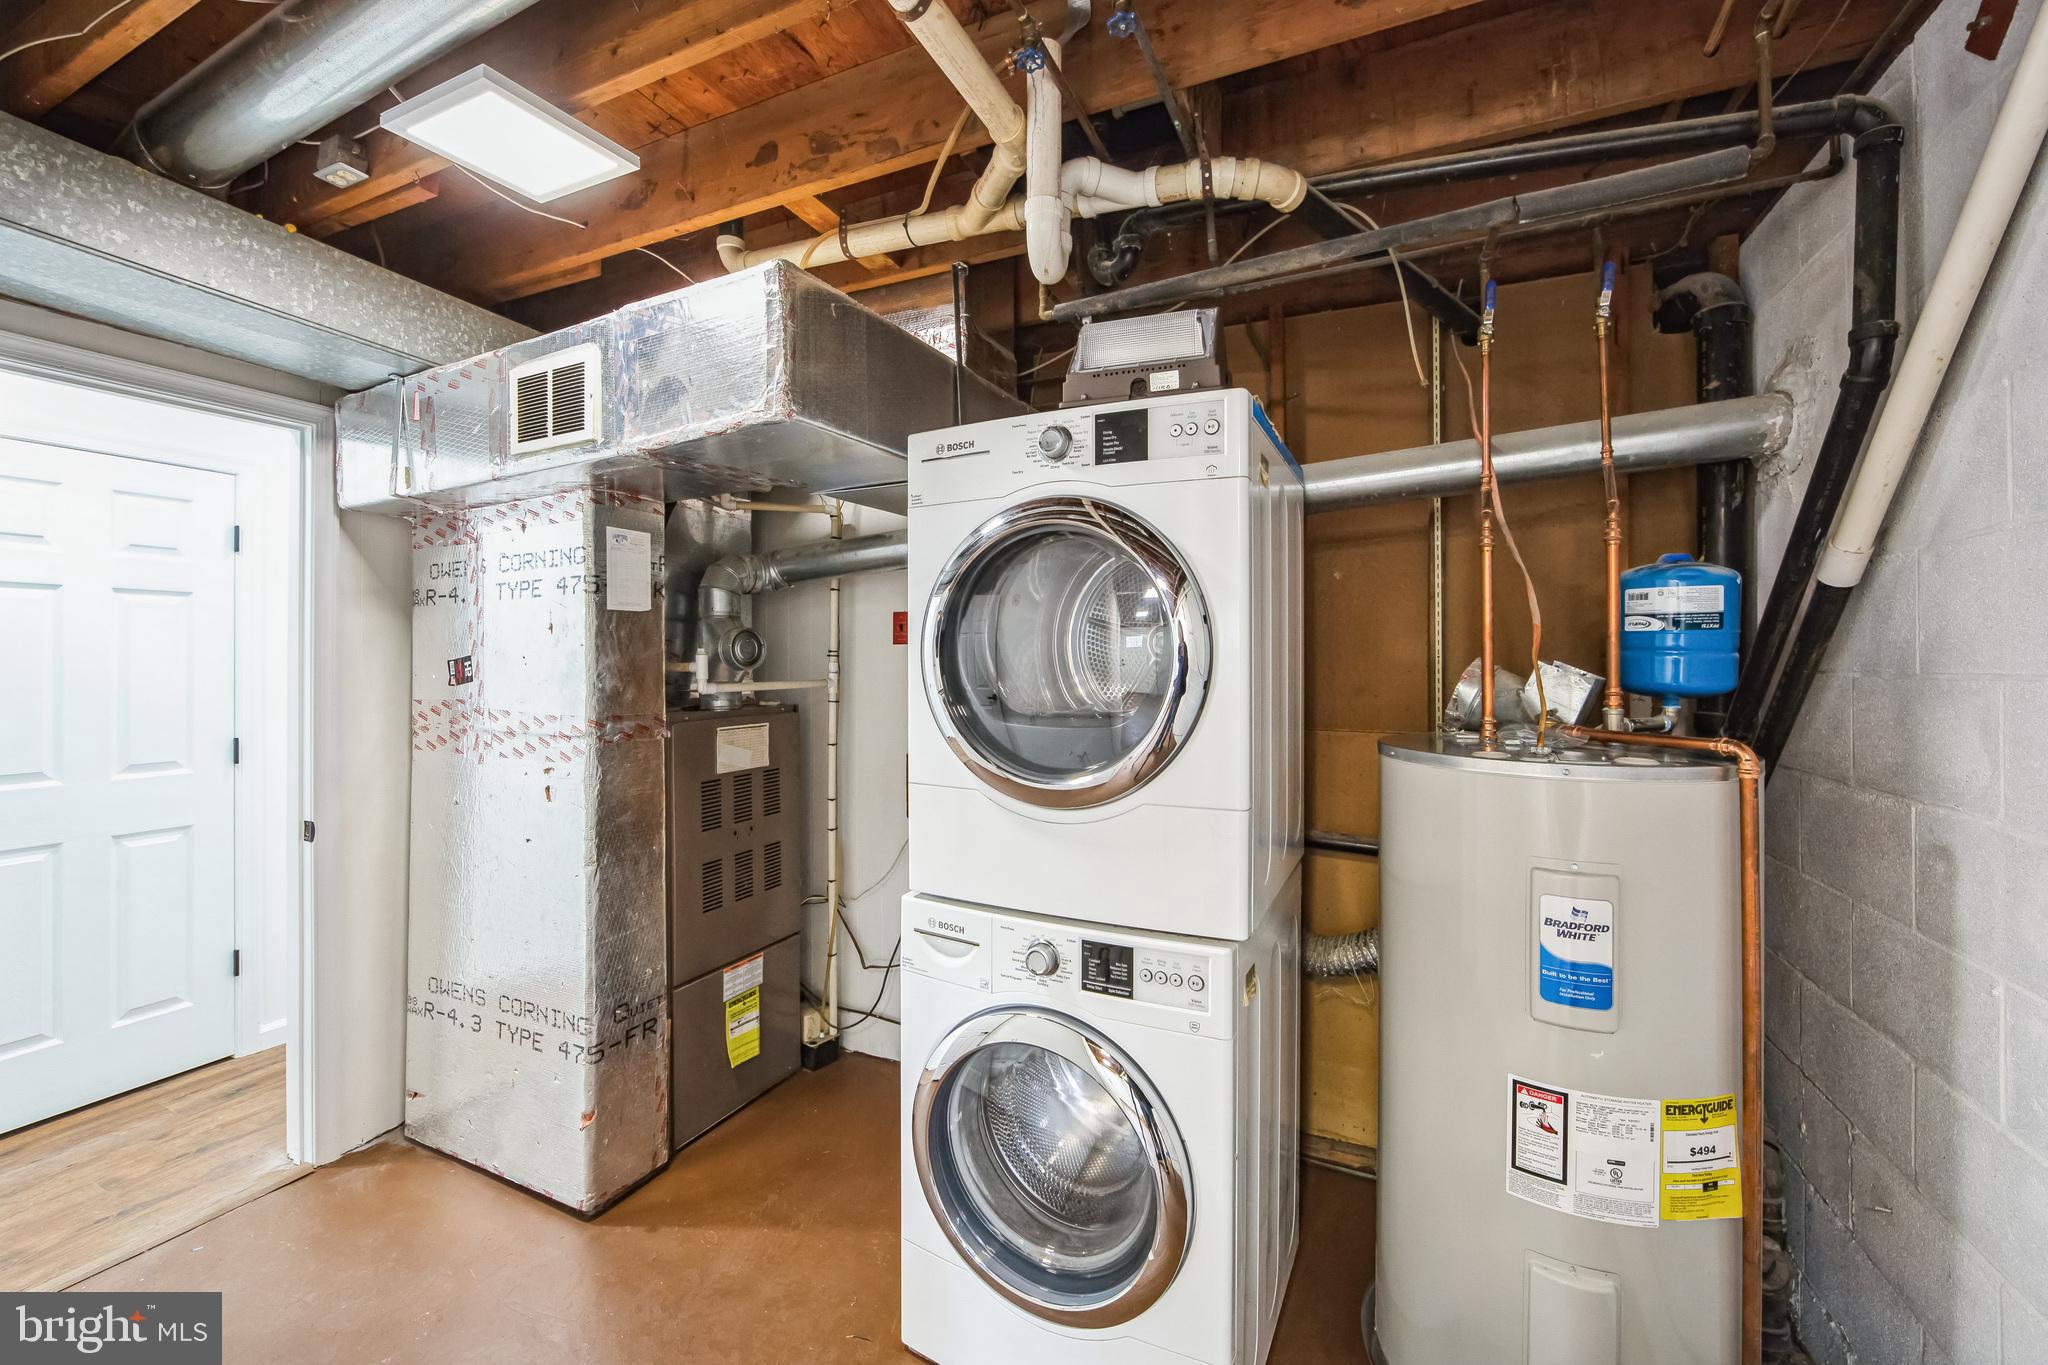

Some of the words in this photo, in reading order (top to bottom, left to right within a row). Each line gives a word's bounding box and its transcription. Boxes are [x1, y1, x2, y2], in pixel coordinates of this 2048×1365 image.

[947, 440, 975, 452] BOSCH
[499, 546, 587, 574] CORNING
[496, 579, 543, 601] TYPE
[938, 920, 965, 934] BOSCH
[1544, 917, 1610, 933] BRADFORD
[1556, 929, 1596, 942] WHITE
[1542, 969, 1557, 977] Built
[428, 977, 486, 1007] OWENS
[498, 995, 592, 1036] CORNING
[423, 1001, 482, 1033] R-4.3
[496, 1020, 544, 1053] TYPE
[558, 1017, 658, 1066] 475-FR
[1529, 1089, 1557, 1103] DANGER
[1665, 1099, 1733, 1119] ENERGYGUIDE
[1690, 1145, 1716, 1157] $494
